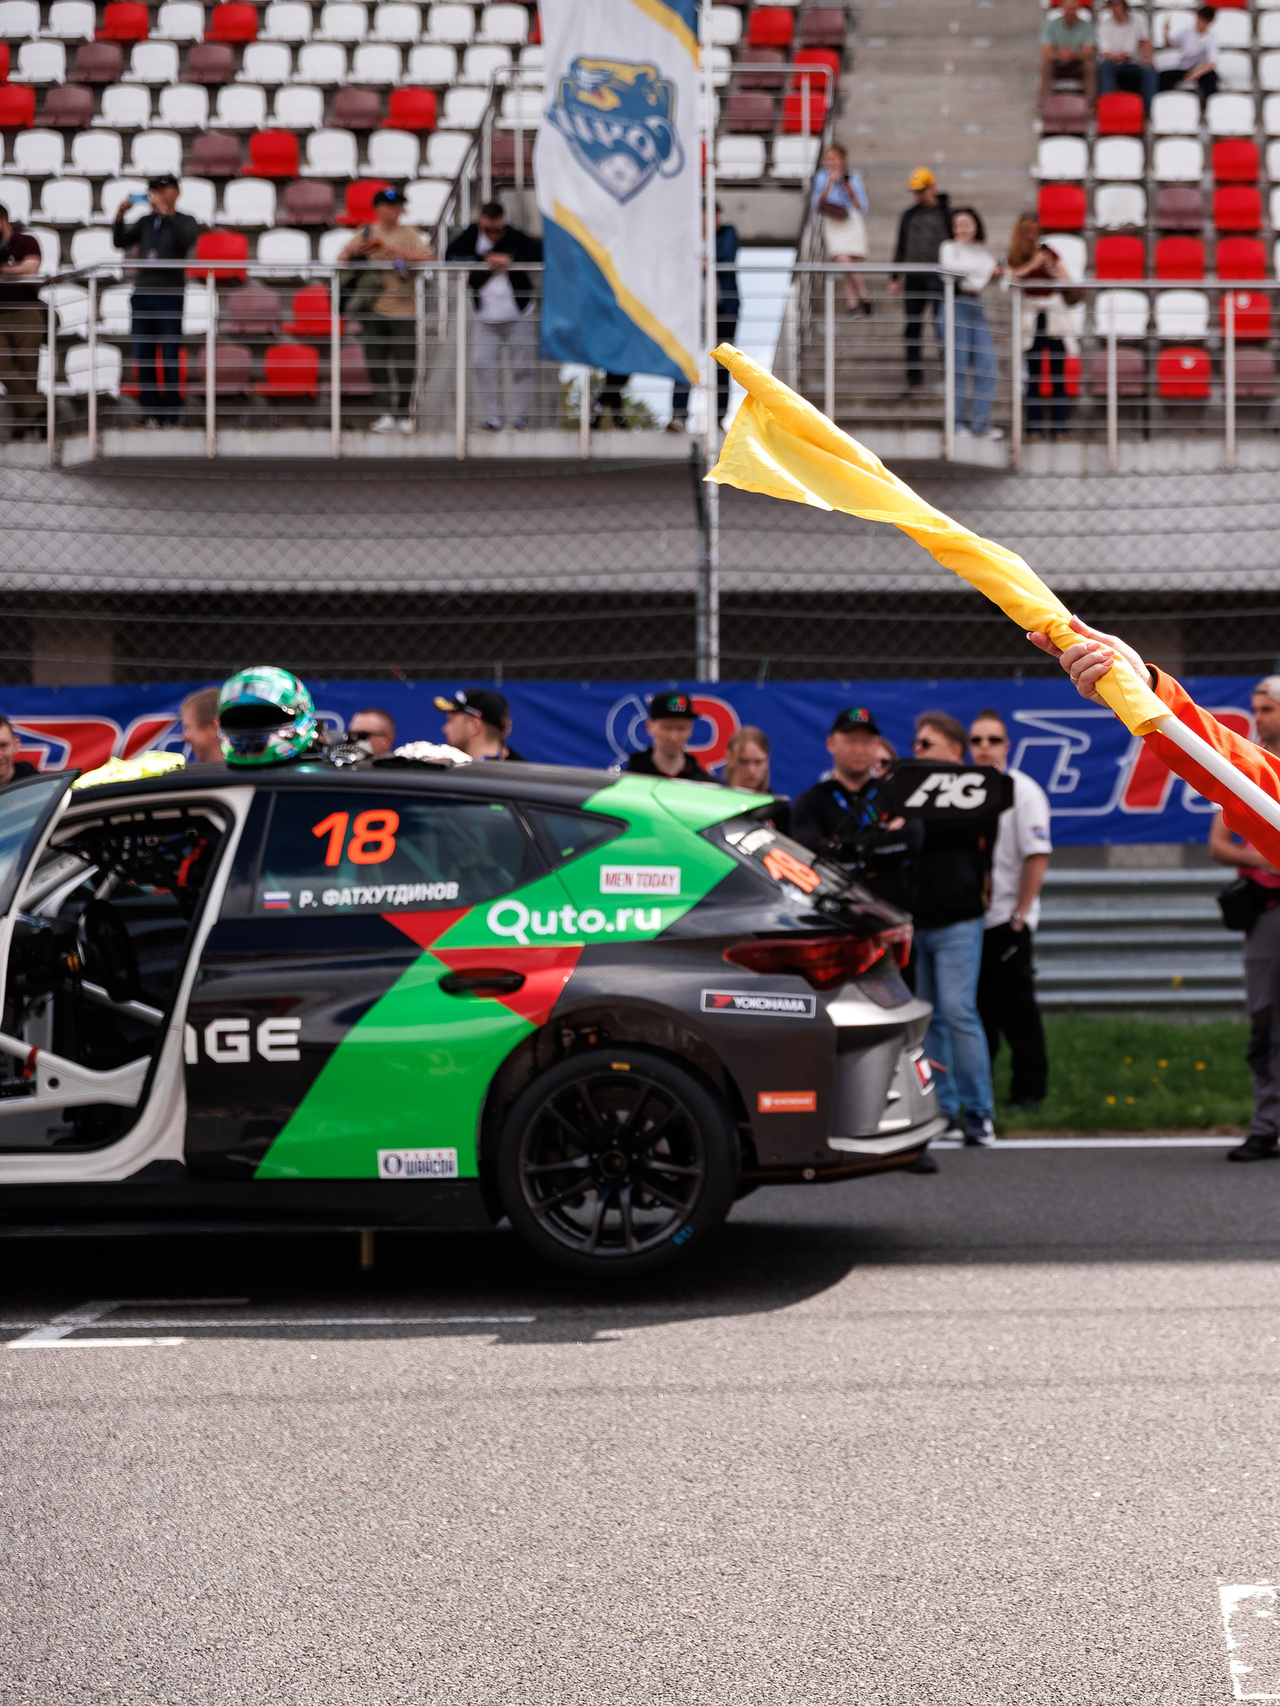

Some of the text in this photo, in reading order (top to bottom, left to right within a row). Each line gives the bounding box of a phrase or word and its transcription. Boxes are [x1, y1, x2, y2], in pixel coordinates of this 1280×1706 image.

[312, 809, 399, 866] 18
[605, 873, 676, 888] MEN TODAY
[763, 848, 821, 894] 18
[298, 882, 459, 908] Р. ФАТХУТДИНОВ
[487, 899, 661, 945] Quto.ru
[732, 996, 807, 1012] YOKOHAMA
